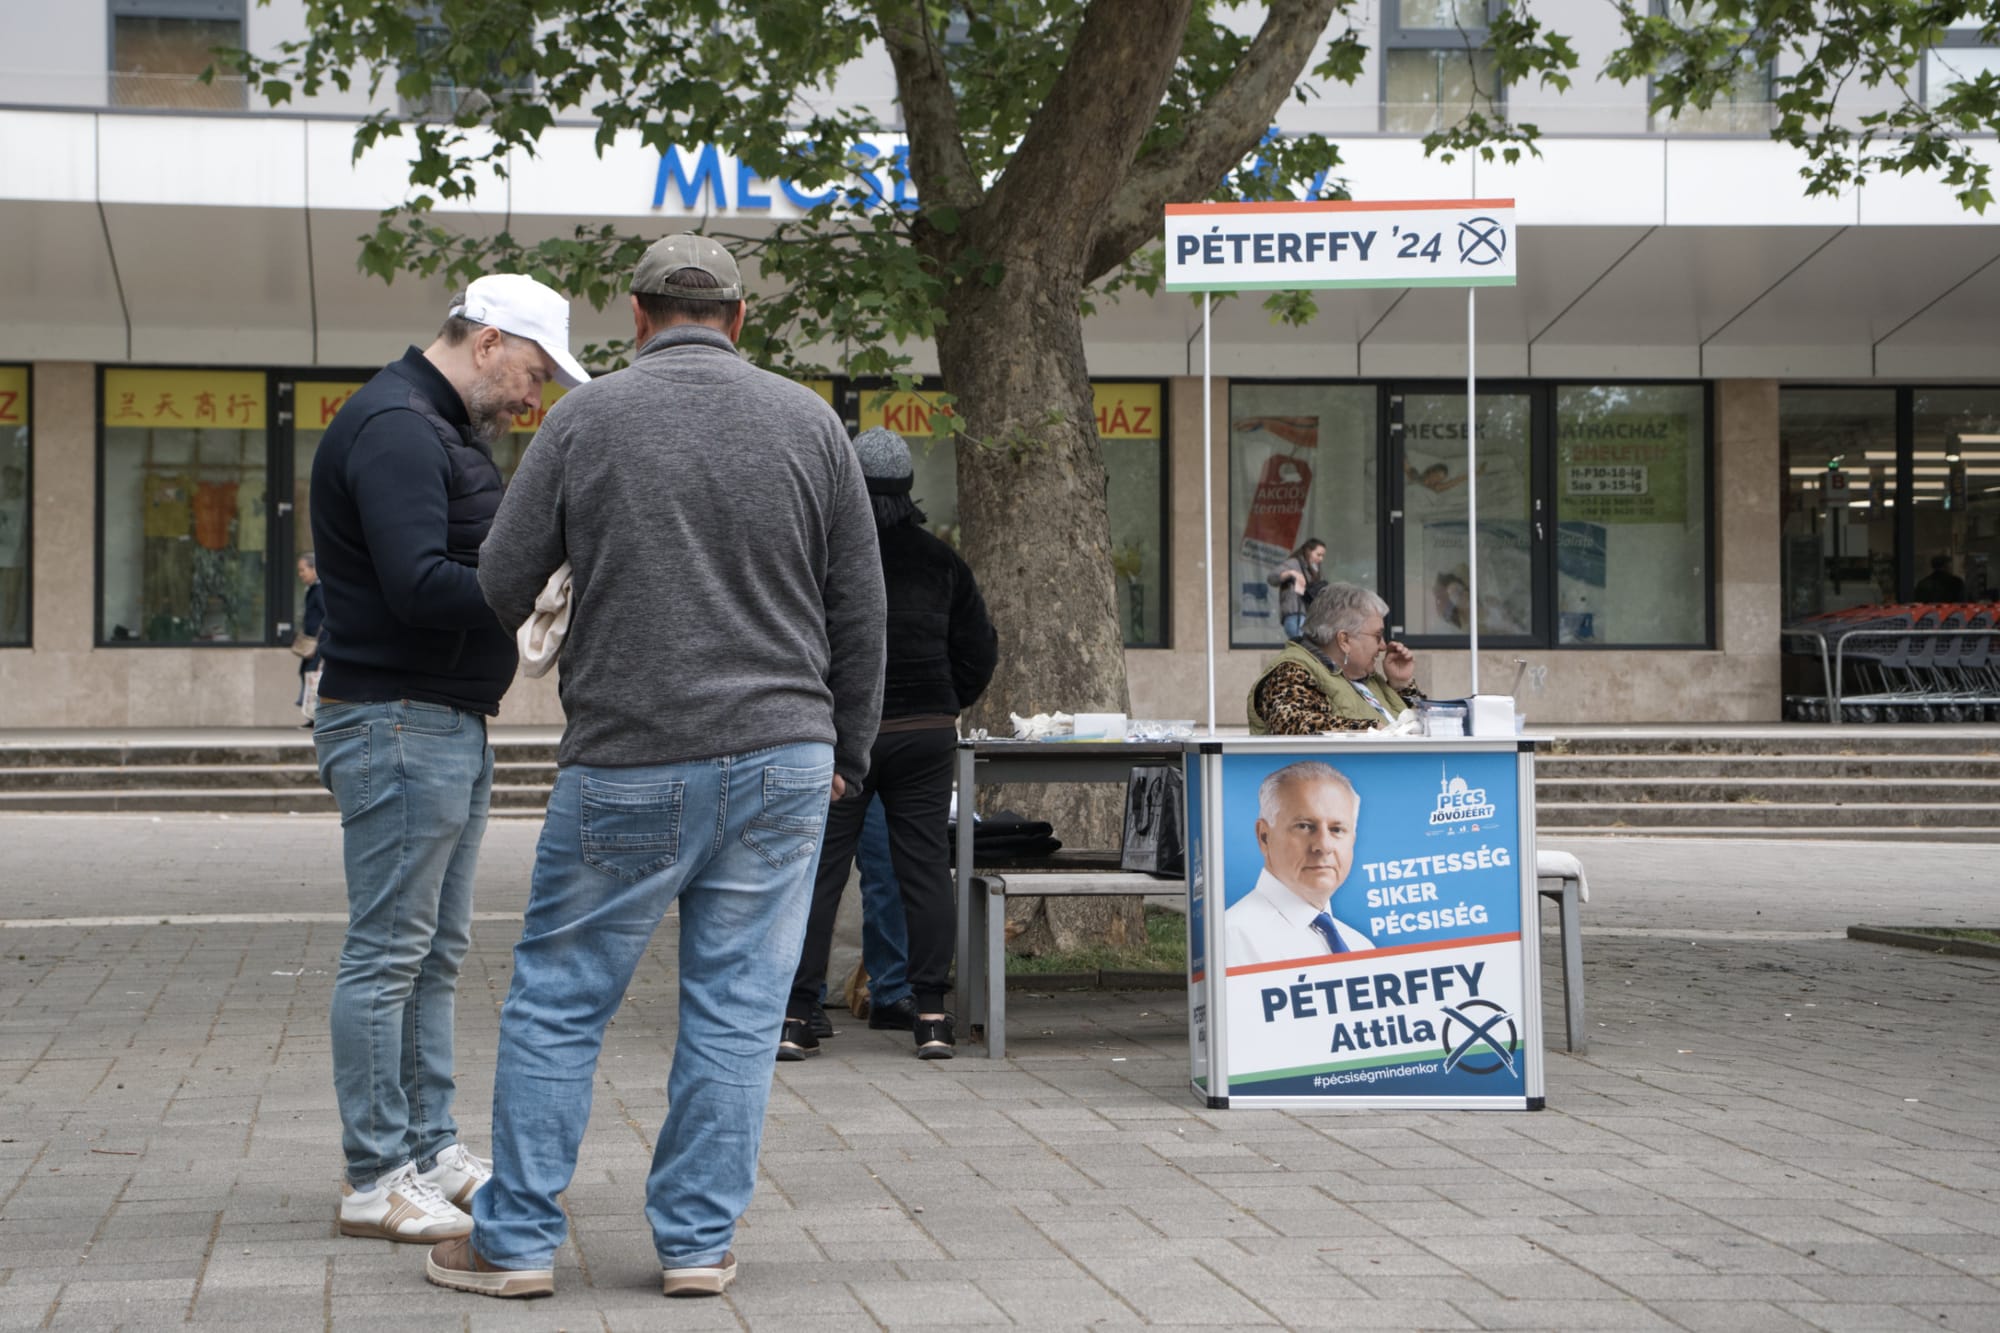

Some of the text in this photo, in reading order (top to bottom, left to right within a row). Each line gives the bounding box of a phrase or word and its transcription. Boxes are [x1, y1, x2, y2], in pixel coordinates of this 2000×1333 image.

[1177, 226, 1377, 265] PÉTERFFY
[1440, 790, 1484, 809] PÉCS
[1362, 844, 1511, 882] TISZTESSÉG
[1366, 882, 1439, 908] SIKER
[1370, 901, 1488, 936] PÉCSISÉG
[1261, 961, 1485, 1022] PÉTERFFY
[1330, 1014, 1436, 1053] Attila
[1313, 1063, 1439, 1088] #pécsiségmindenkor
